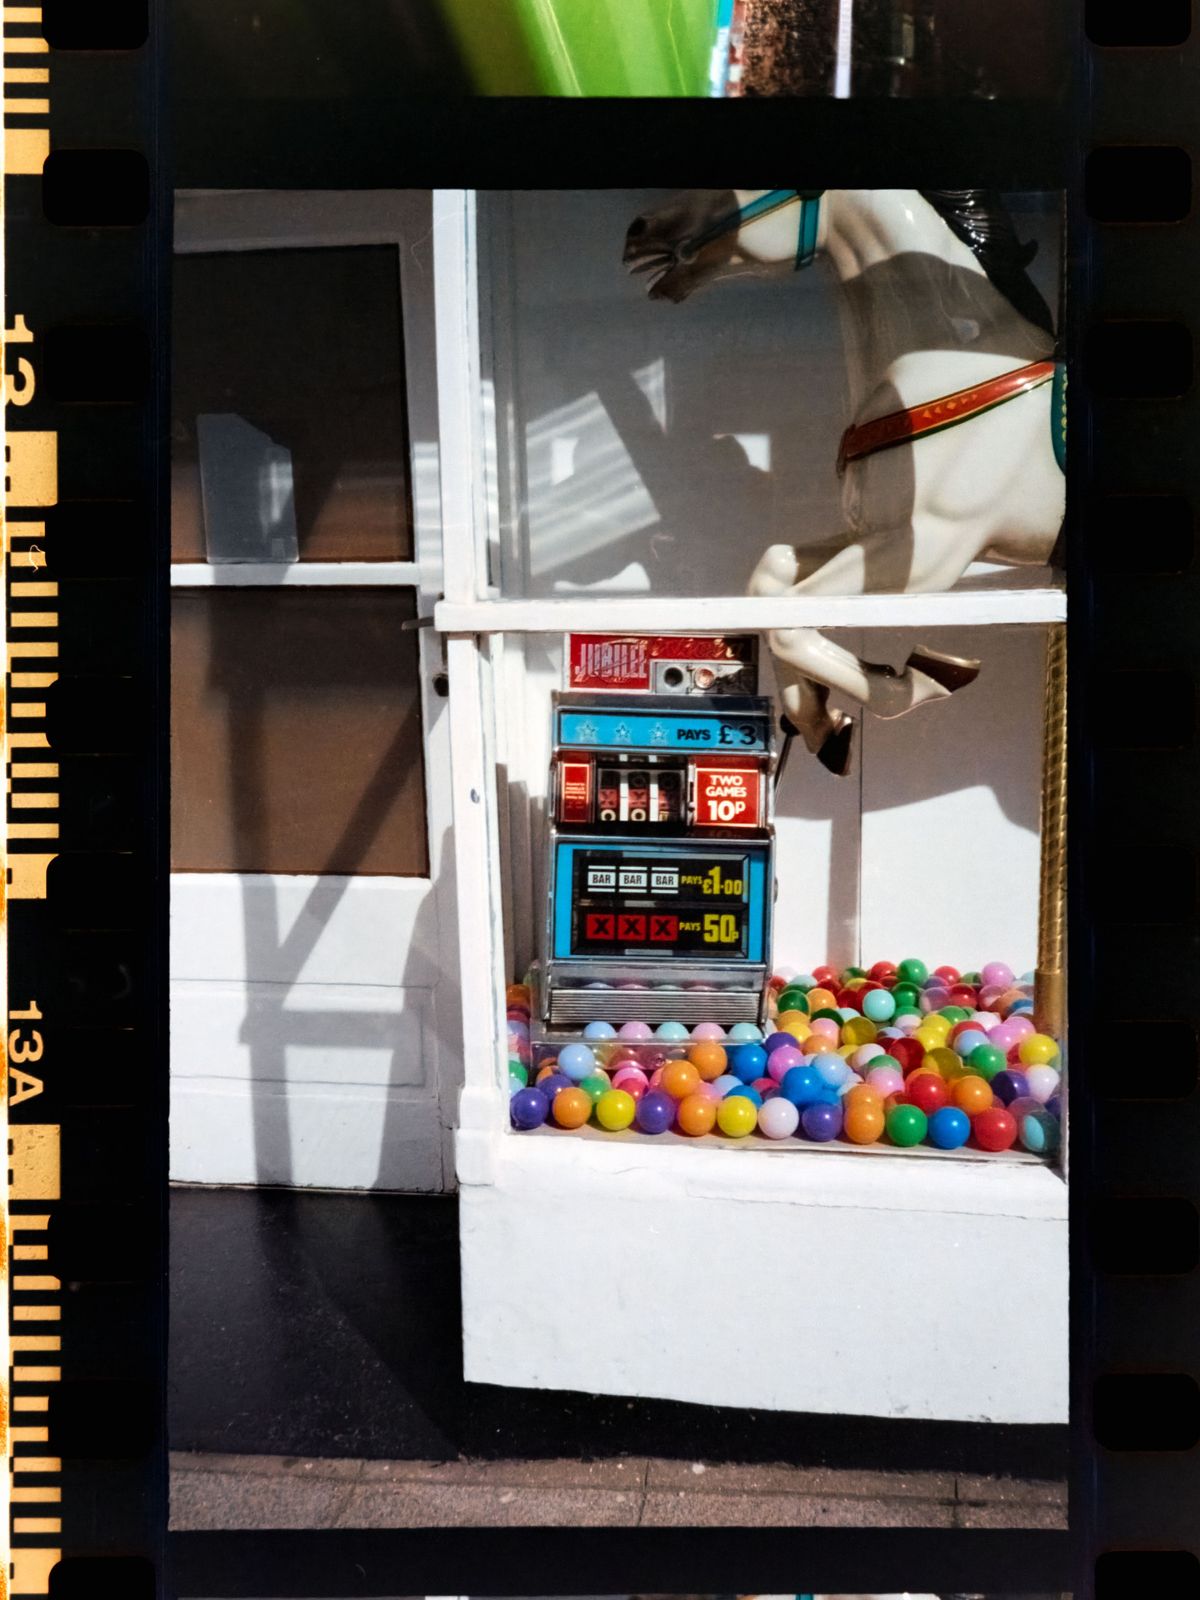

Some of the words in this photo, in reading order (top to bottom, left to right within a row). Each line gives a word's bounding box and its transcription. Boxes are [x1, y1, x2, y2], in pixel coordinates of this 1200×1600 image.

[677, 728, 711, 741] PAYS
[710, 774, 743, 786] TWO
[705, 786, 747, 798] GAMES
[592, 873, 611, 884] BAR
[623, 874, 642, 885] BAR
[656, 875, 674, 886] BAR
[681, 875, 702, 885] PAYS
[679, 921, 701, 931] PAYS
[9, 1000, 44, 1107] 13A
